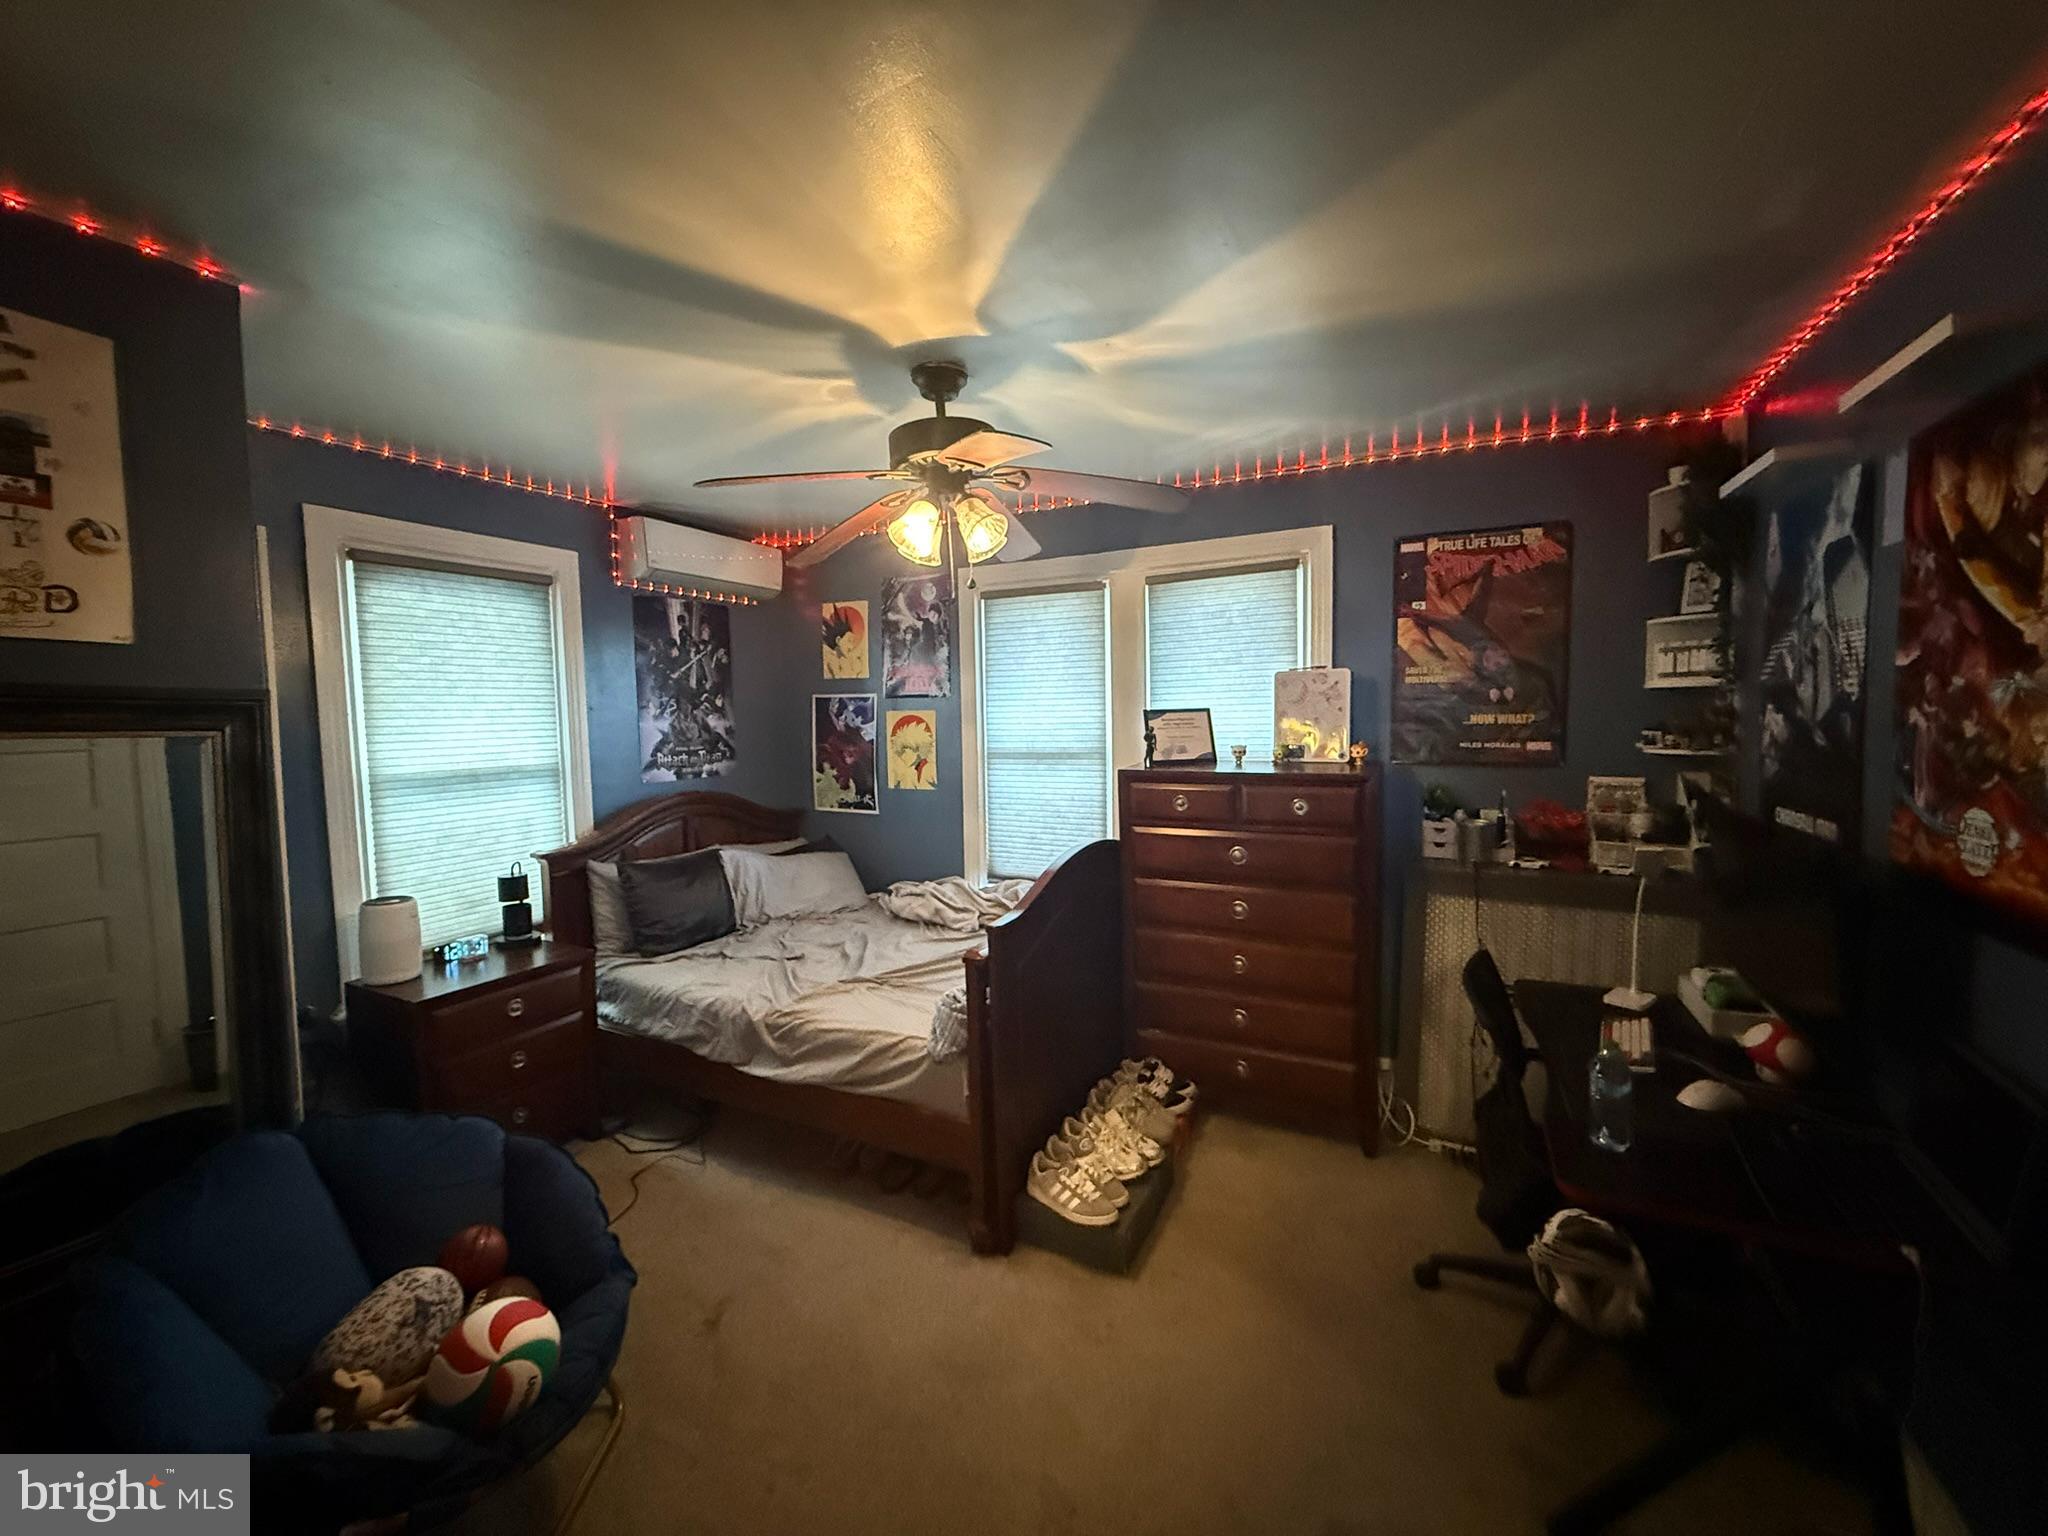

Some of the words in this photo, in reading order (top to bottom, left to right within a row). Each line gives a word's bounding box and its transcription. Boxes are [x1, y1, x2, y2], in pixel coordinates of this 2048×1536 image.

[1440, 539, 1464, 552] TRUE
[1466, 536, 1487, 550] LIFE
[1489, 534, 1520, 548] TALES
